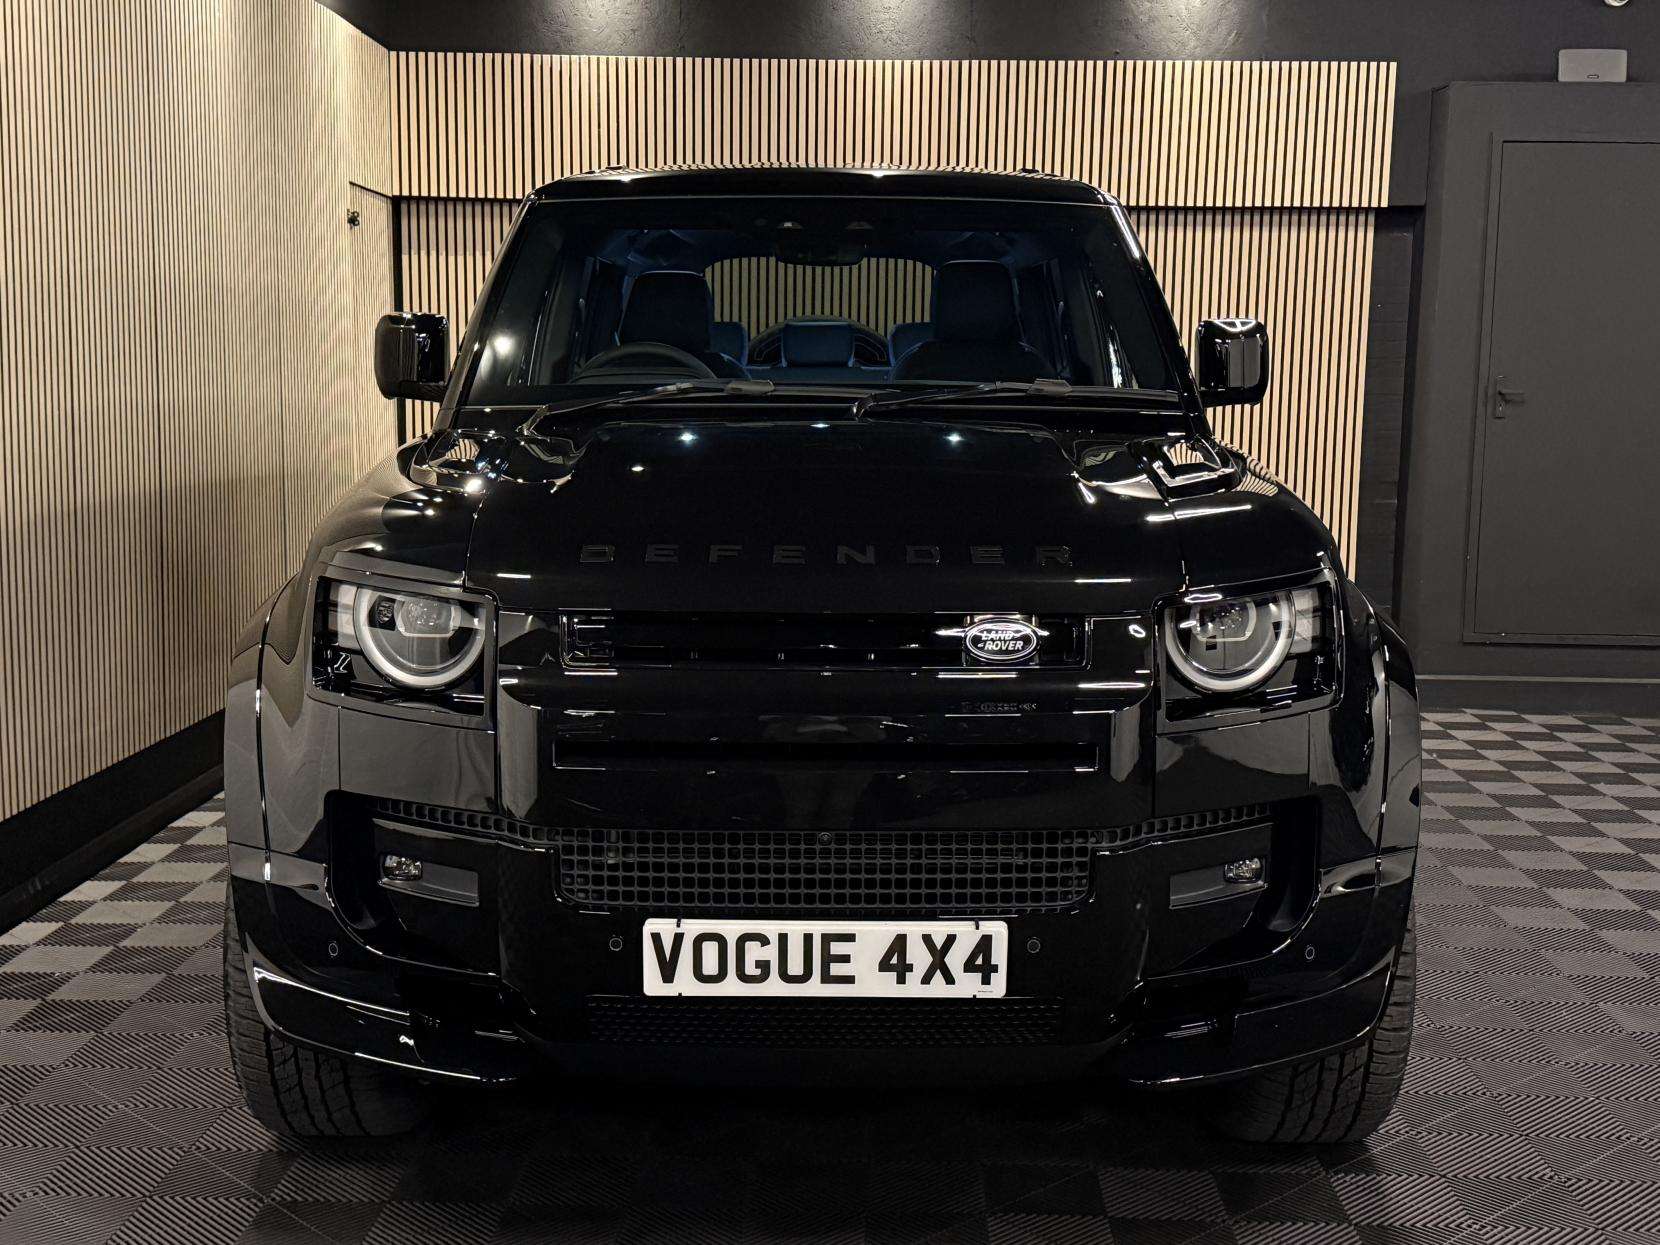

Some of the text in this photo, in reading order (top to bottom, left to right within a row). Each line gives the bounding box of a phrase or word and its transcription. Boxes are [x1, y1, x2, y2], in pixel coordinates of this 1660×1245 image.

[579, 544, 1073, 566] DEFENDER
[981, 629, 1014, 640] LAND
[984, 640, 1024, 651] ROVER
[650, 932, 999, 986] VOGUE 4X4
